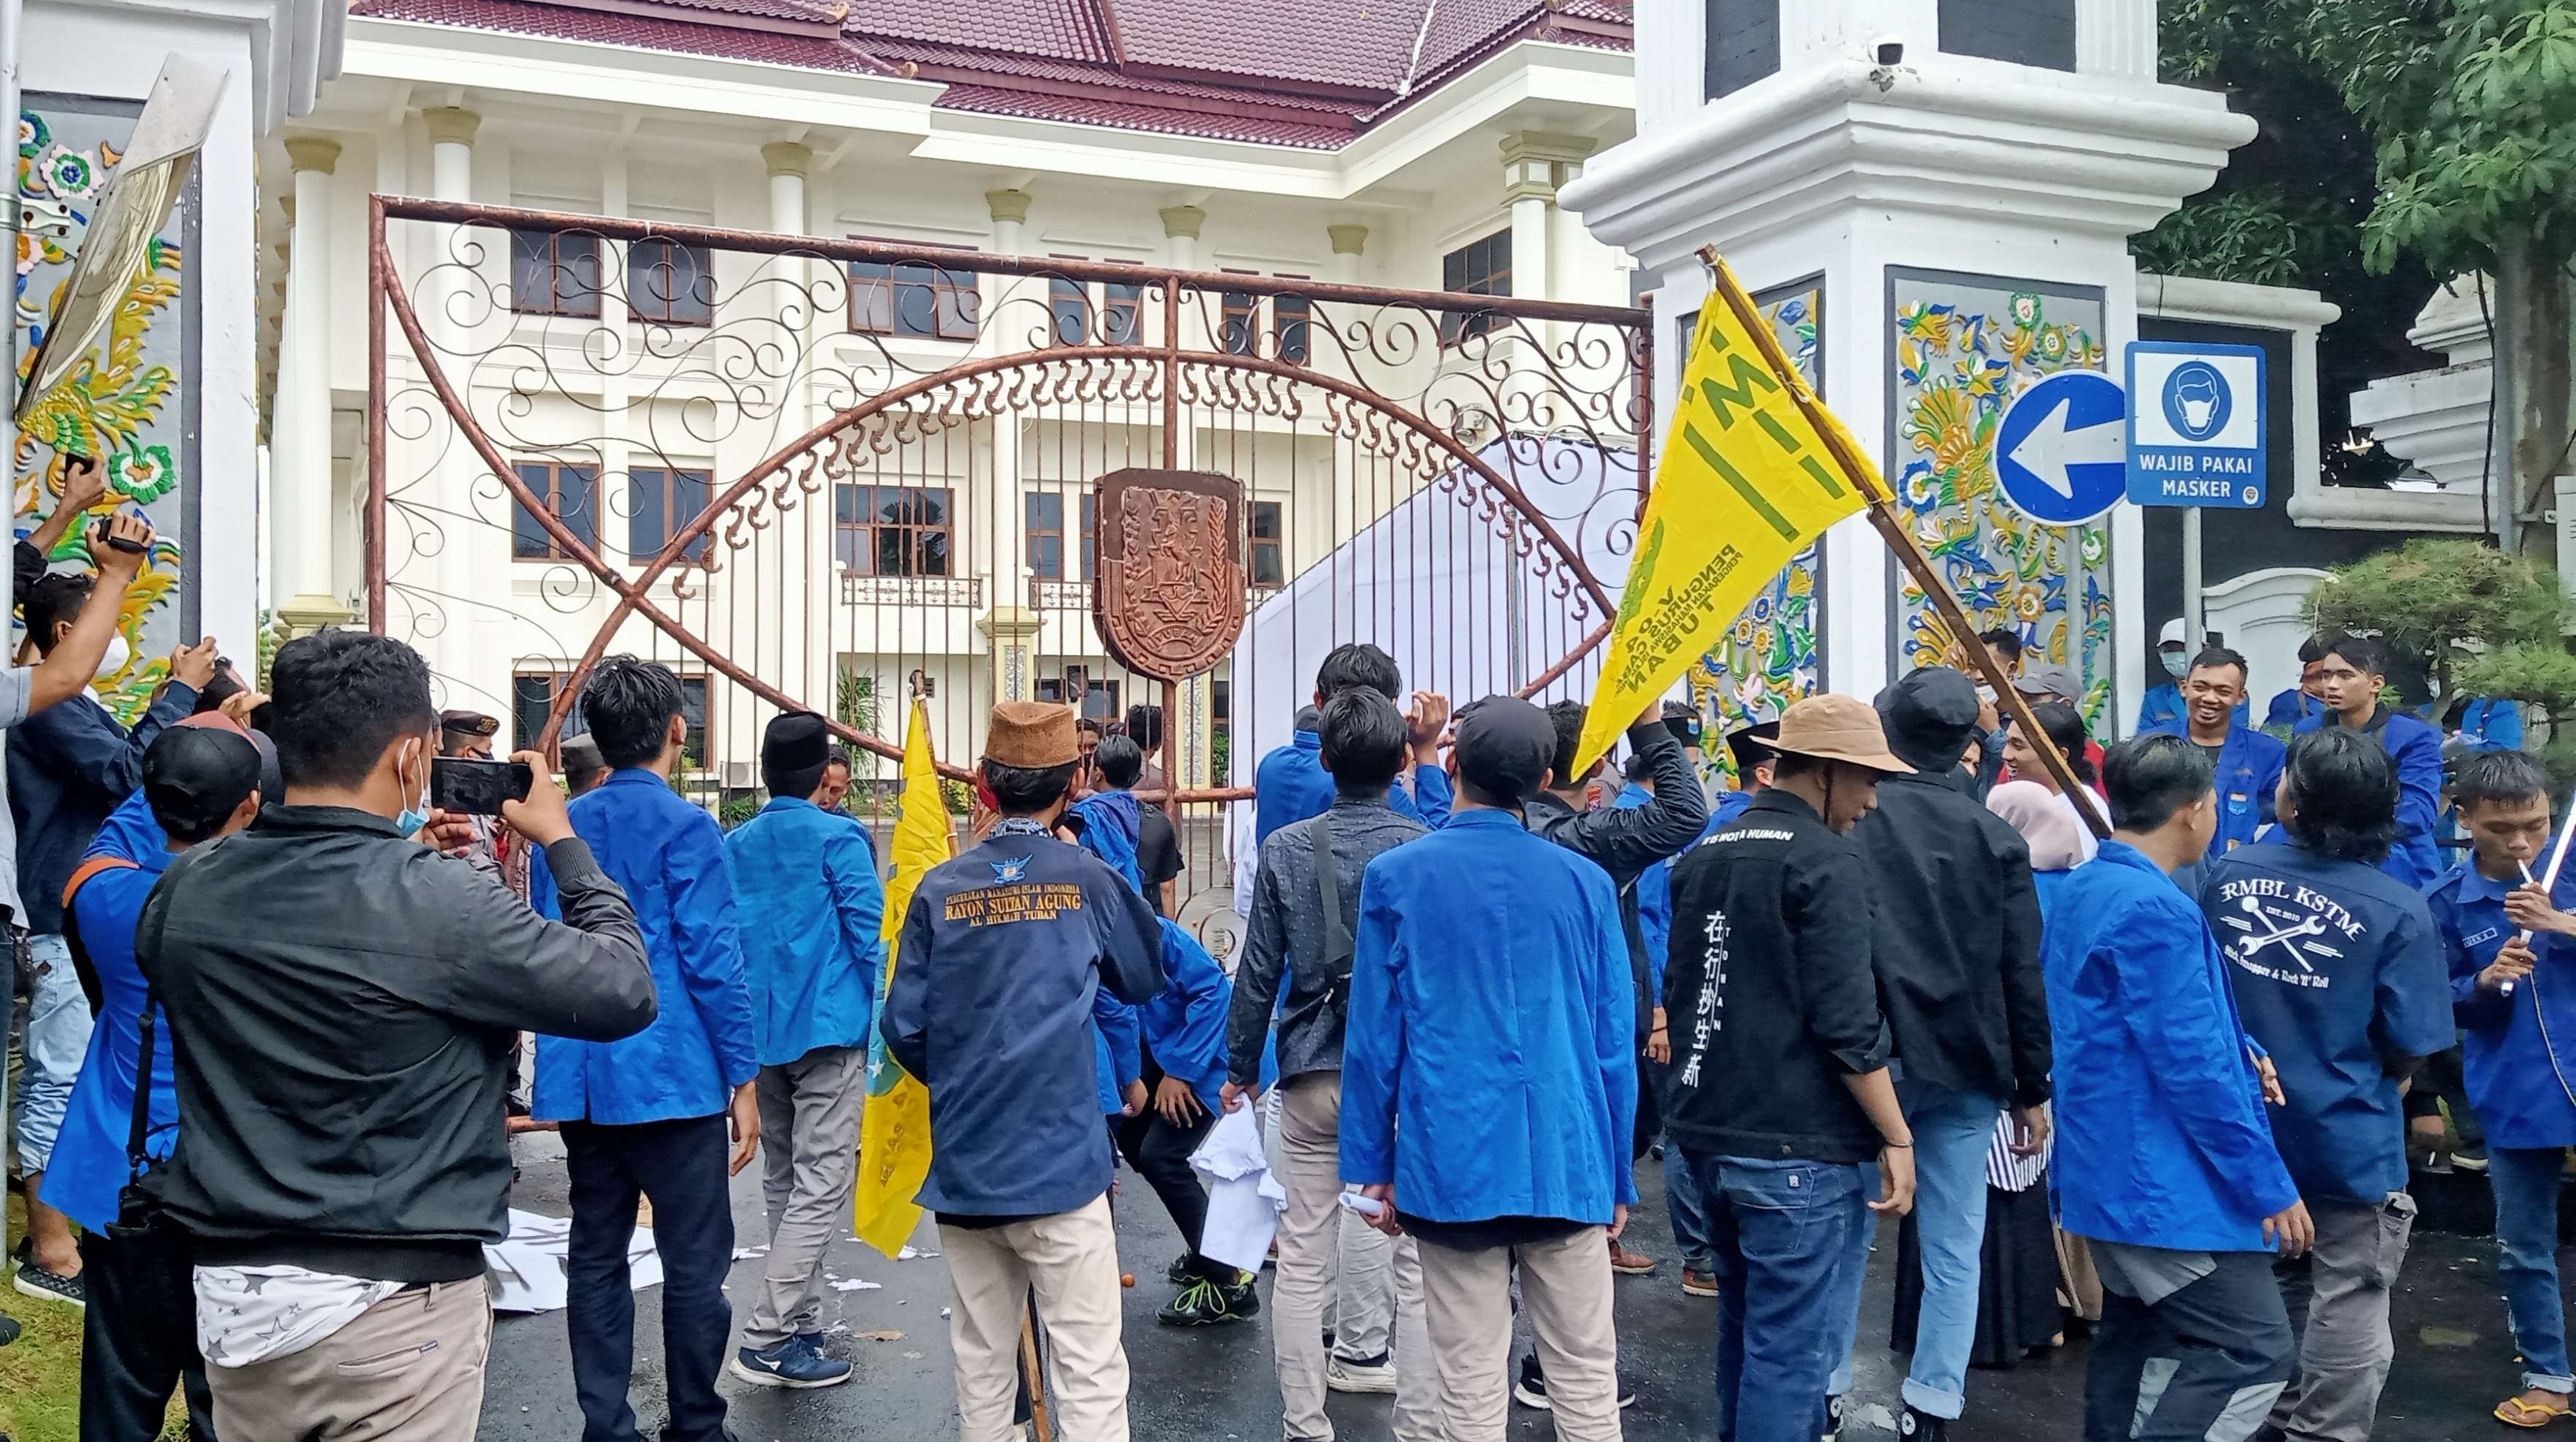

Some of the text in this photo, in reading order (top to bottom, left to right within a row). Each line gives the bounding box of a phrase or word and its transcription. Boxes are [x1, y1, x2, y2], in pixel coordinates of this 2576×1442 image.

[2139, 454, 2252, 474] WAJIB PAKAI
[2162, 479, 2231, 498] MASKER
[1718, 831, 1740, 842] NOT
[1739, 829, 1746, 840] A
[1747, 829, 1794, 841] HUMAN
[2219, 879, 2290, 903] RMBL
[944, 894, 1082, 920] RAYON SULTAN AGUNG
[2282, 911, 2300, 922] 2010
[969, 910, 1057, 927] AL HIKMAH TUBAN
[2271, 968, 2279, 979] &
[2312, 975, 2329, 988] Roll
